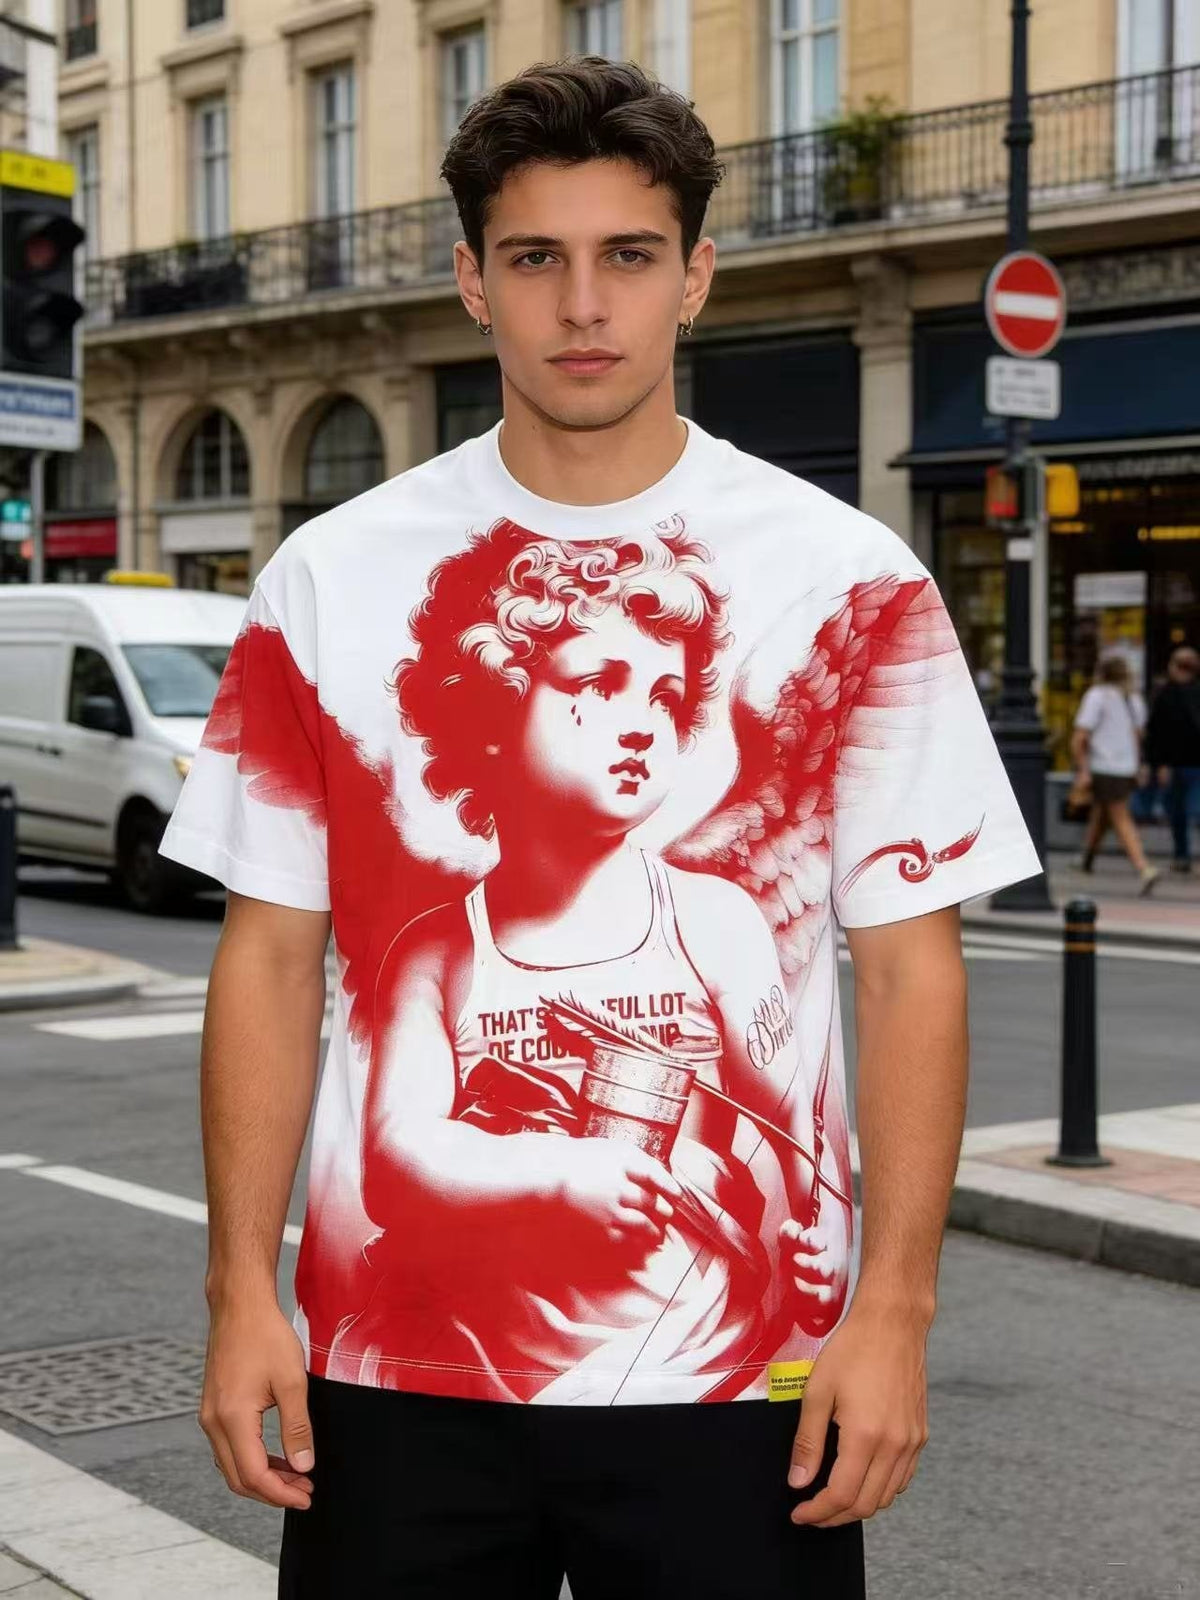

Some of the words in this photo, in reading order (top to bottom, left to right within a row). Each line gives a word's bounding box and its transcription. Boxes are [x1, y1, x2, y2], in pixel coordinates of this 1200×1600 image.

[477, 1006, 548, 1037] THAT'S
[601, 996, 645, 1019] FUL
[649, 992, 686, 1017] LOT
[489, 1039, 515, 1061] OF
